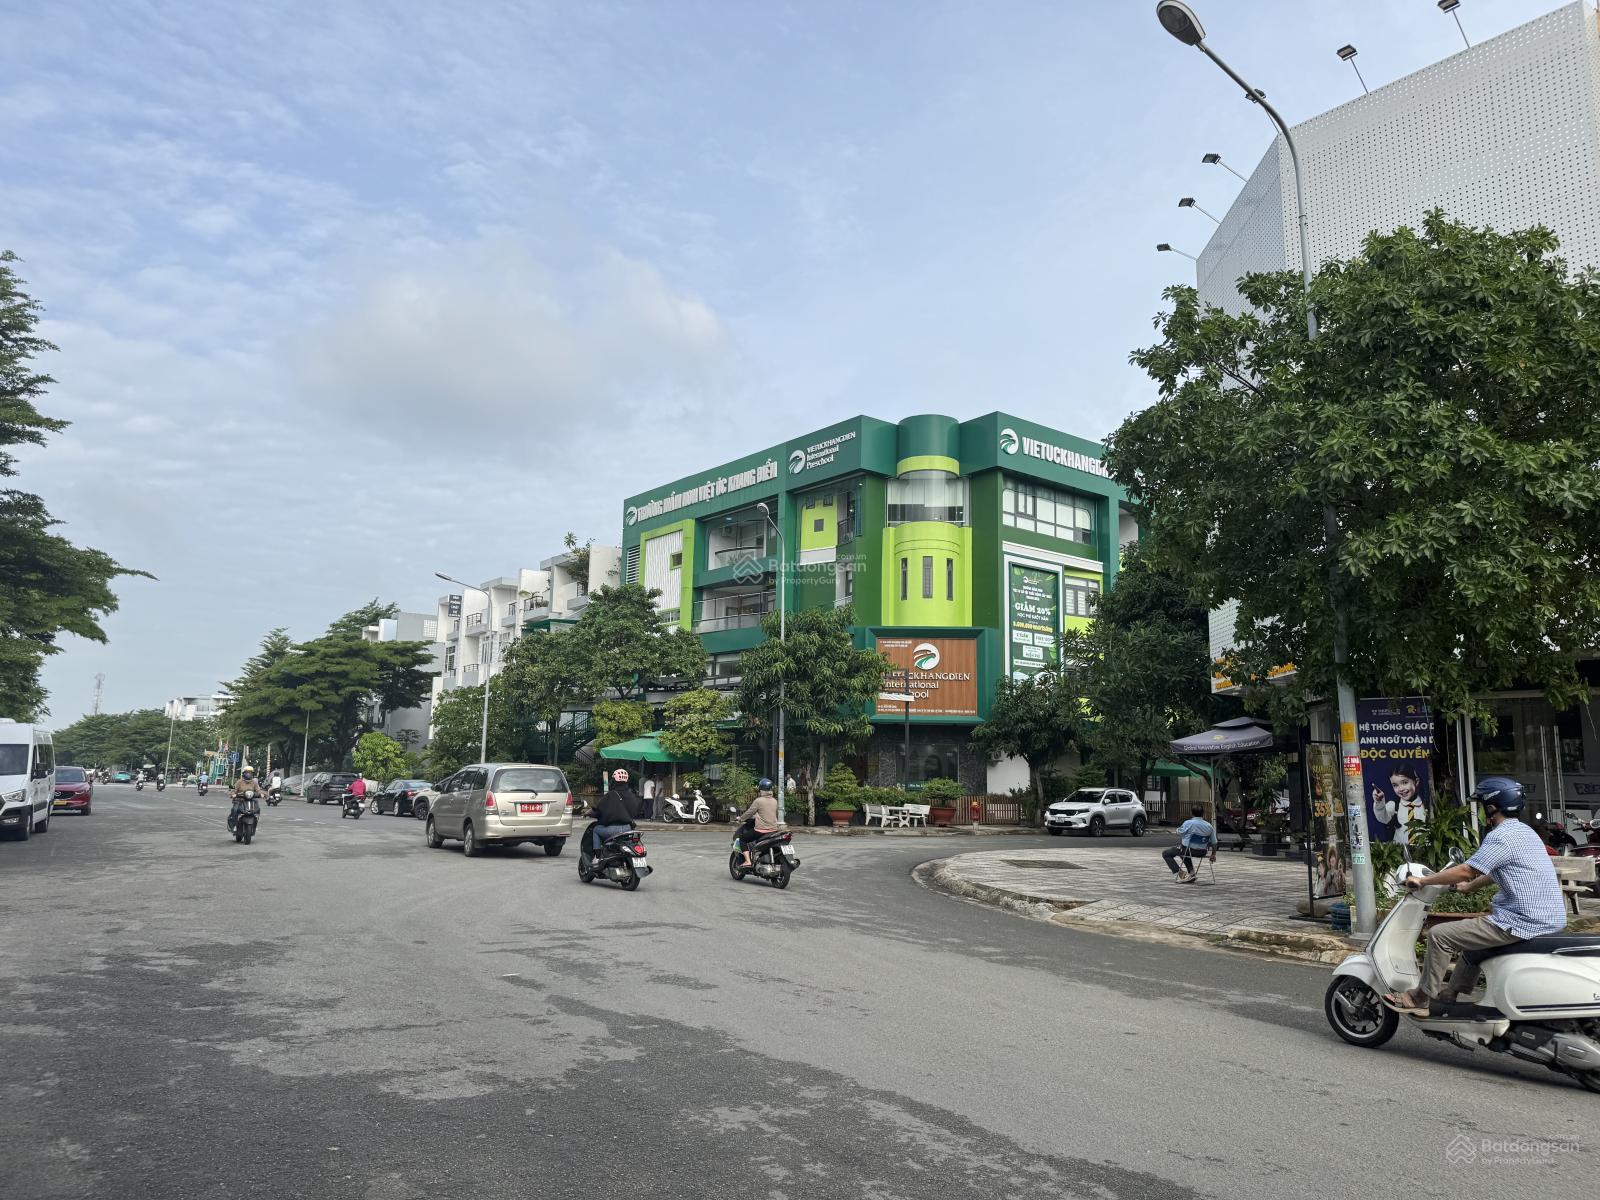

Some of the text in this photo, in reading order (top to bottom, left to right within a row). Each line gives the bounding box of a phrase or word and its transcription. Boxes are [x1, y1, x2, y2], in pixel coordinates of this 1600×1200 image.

[807, 445, 839, 461] International
[1022, 437, 1112, 479] VIETUCKHANGDI
[807, 454, 834, 469] Preschool
[699, 480, 716, 502] VIỆT
[728, 468, 757, 492] KHANG
[1014, 601, 1051, 616] GIẢM 20%
[882, 672, 971, 681] ETCKHANGDIEN
[1360, 722, 1370, 733] HỆ
[1371, 720, 1403, 731] THỐNG
[1404, 720, 1429, 731] GIÁO
[1360, 736, 1379, 744] ANH
[1380, 734, 1400, 744] NGỮ
[1401, 735, 1428, 744] TOÀN
[1360, 745, 1430, 761] ĐỘC QUYỀN
